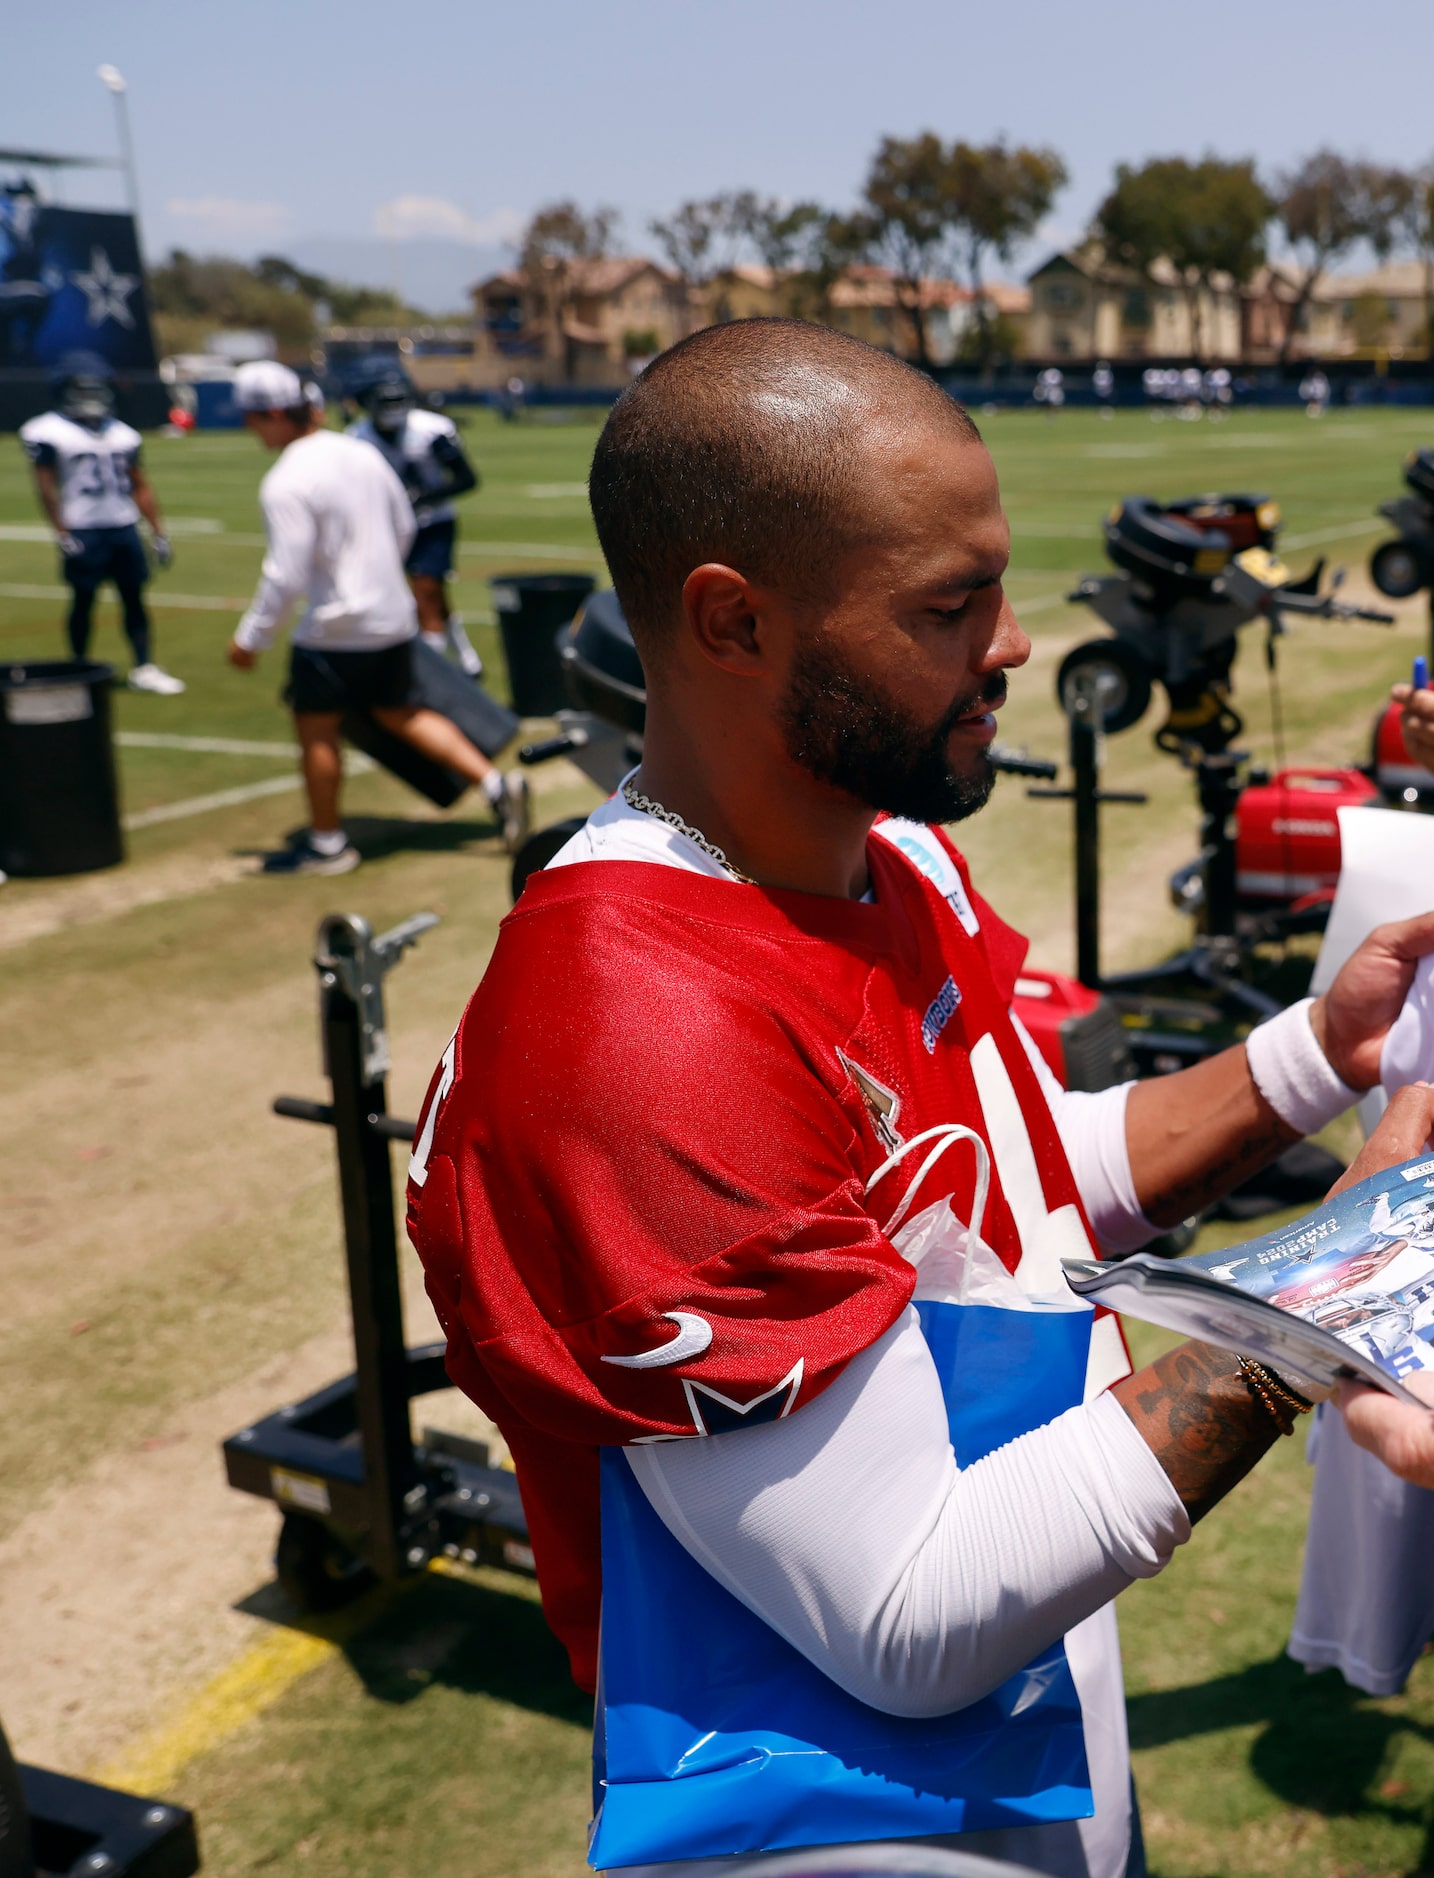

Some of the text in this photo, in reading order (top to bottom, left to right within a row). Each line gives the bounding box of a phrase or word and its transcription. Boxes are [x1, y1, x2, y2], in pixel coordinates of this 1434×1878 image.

[1279, 1221, 1315, 1241] American
[1297, 1218, 1337, 1244] CAMP
[1259, 1225, 1341, 1265] TRAINING
